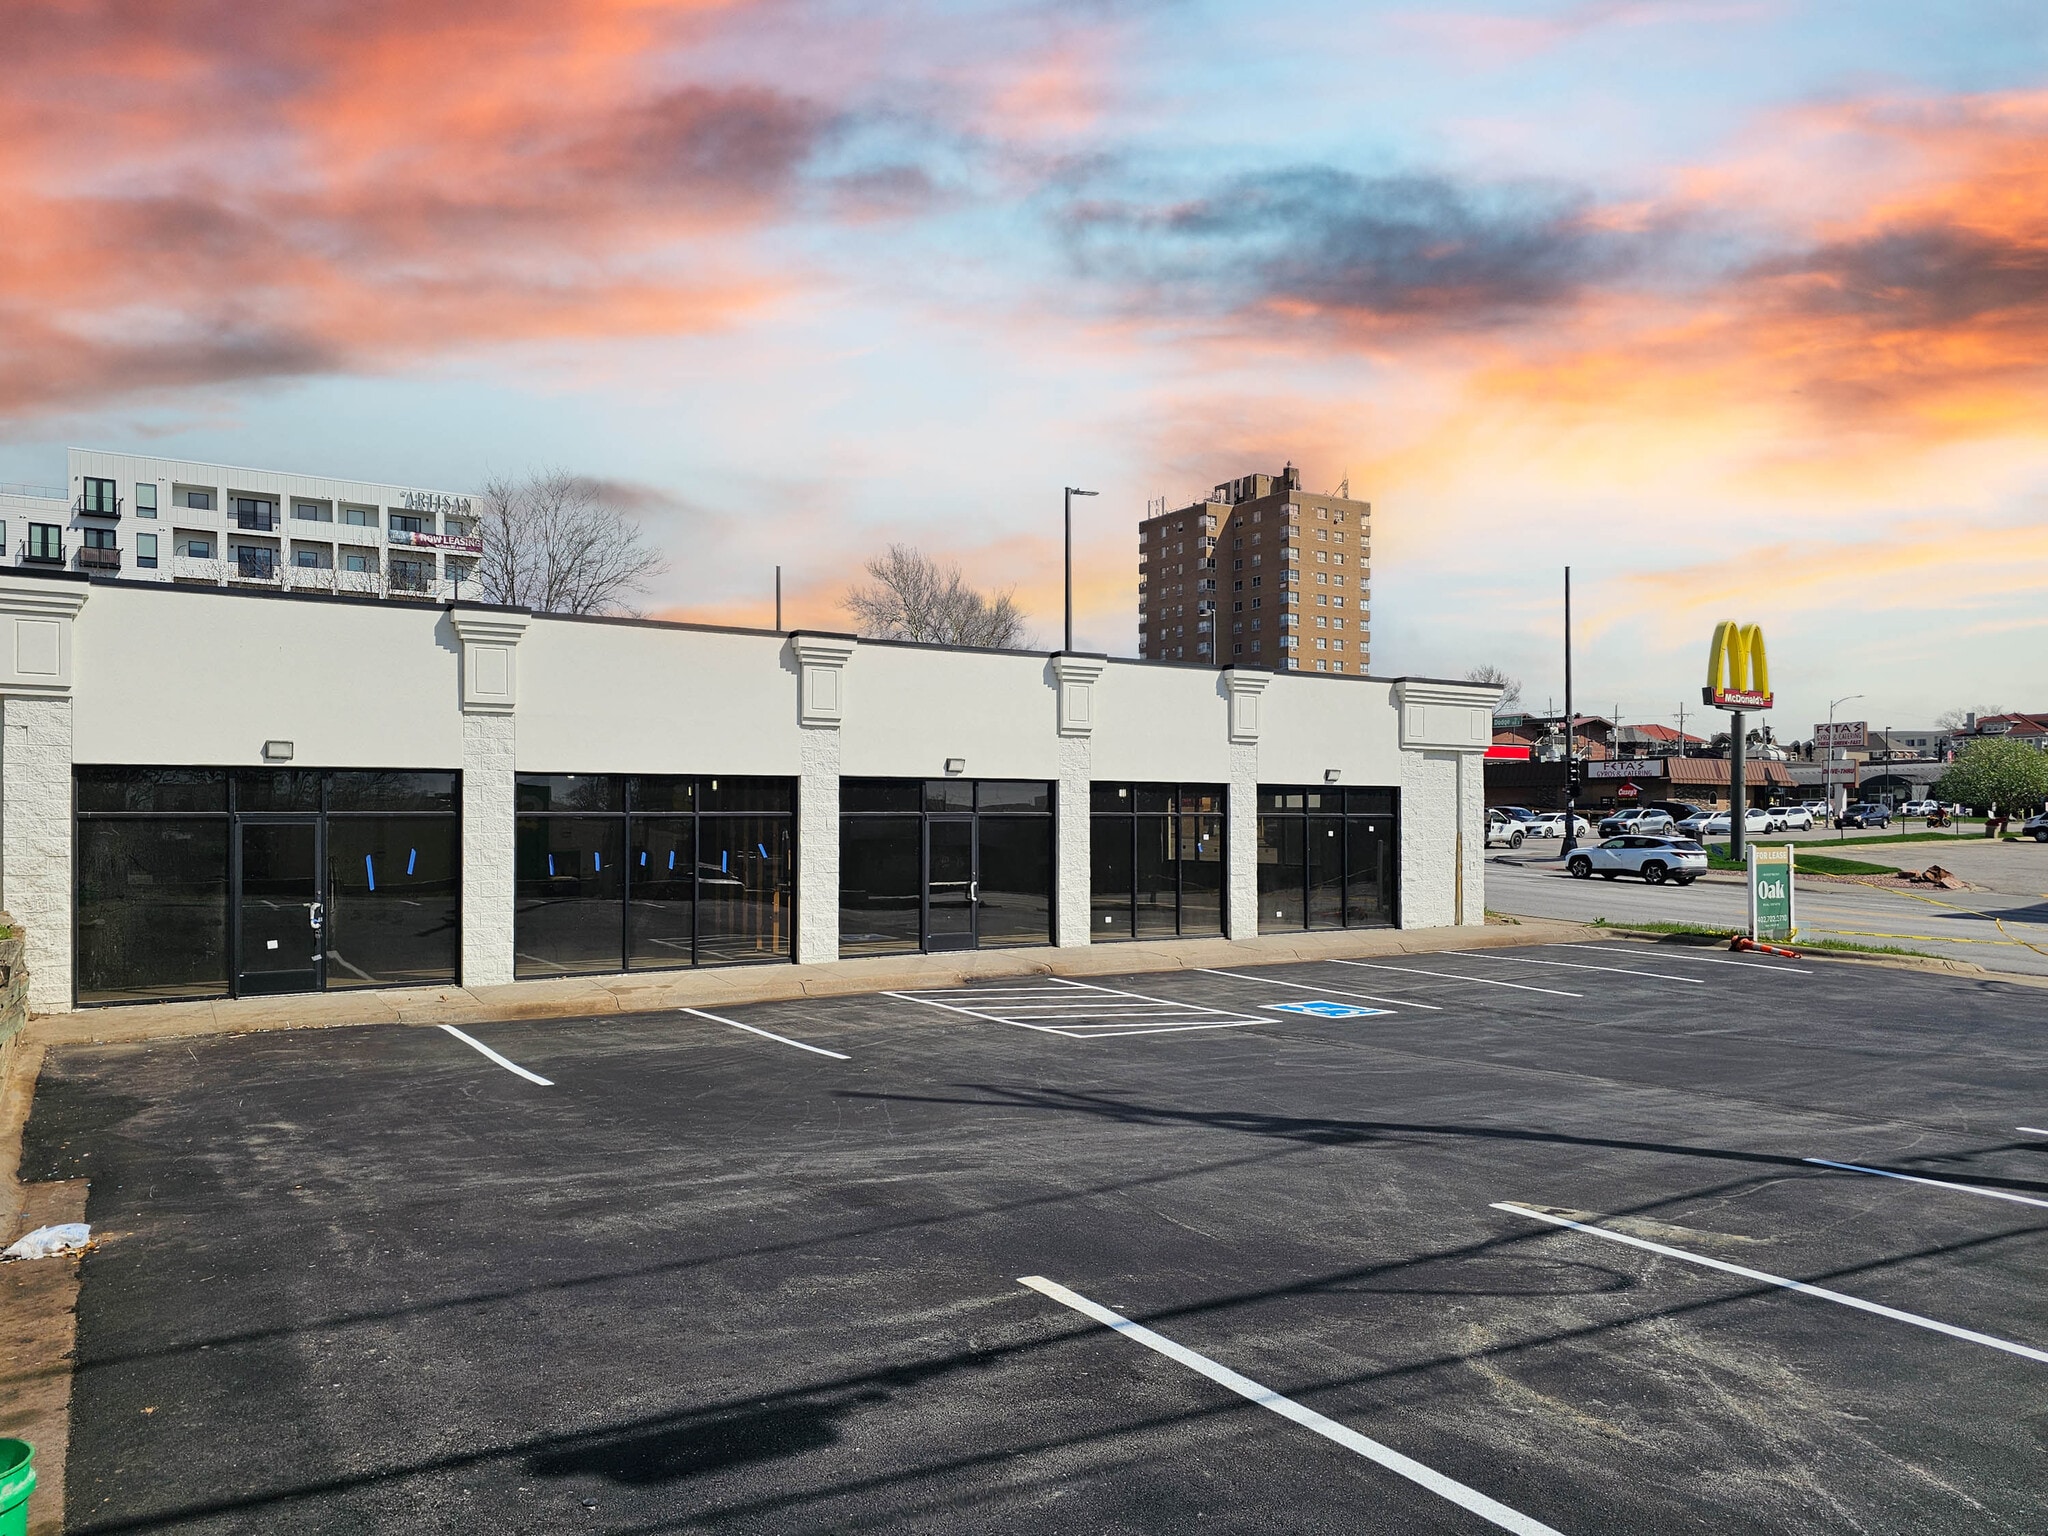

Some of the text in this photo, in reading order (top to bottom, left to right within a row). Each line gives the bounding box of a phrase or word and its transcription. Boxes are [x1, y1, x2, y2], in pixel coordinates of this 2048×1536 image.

[406, 491, 471, 512] ARTISAN
[420, 533, 442, 543] NOW
[443, 536, 481, 547] LEASING
[1725, 693, 1764, 705] McDonald's
[1603, 761, 1645, 770] FETA'S
[1618, 788, 1638, 797] Casey's
[1769, 851, 1787, 859] LEASE
[1758, 880, 1785, 900] Oak
